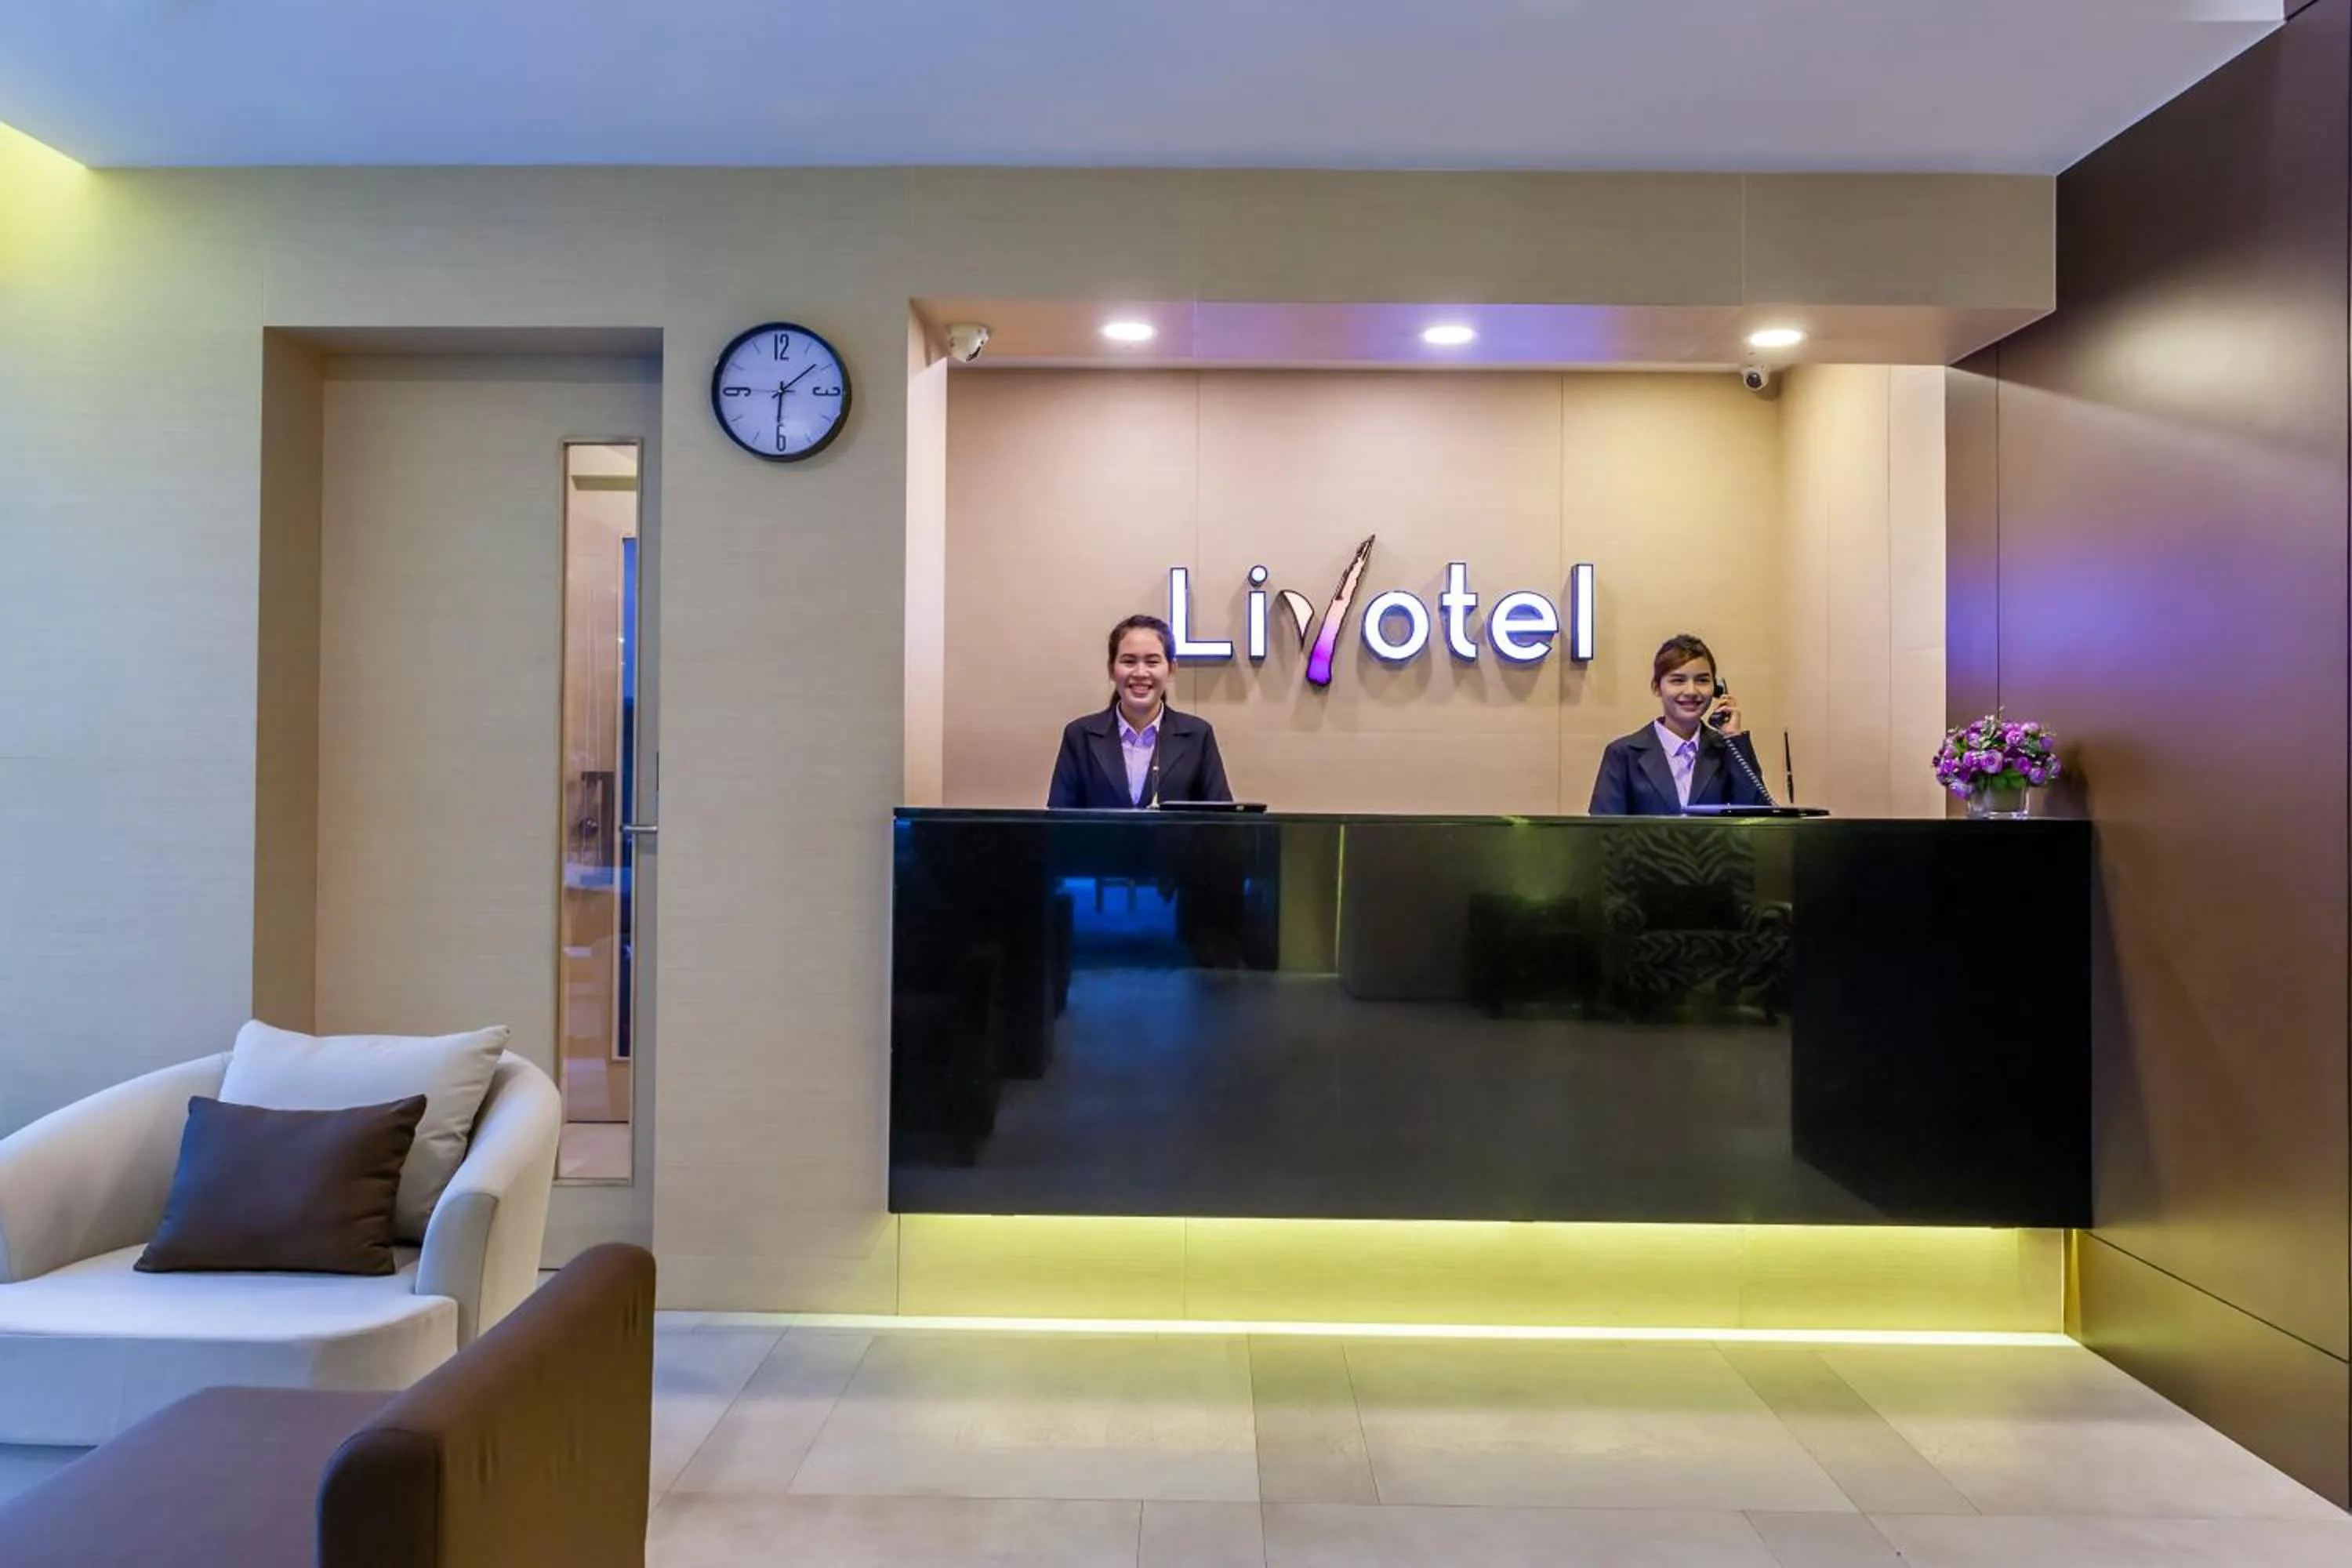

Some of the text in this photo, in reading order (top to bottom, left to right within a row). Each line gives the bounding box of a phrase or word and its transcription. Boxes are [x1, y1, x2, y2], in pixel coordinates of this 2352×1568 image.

[774, 333, 789, 361] 12
[723, 387, 751, 397] 9
[812, 387, 841, 397] 3
[776, 423, 786, 452] 6
[1169, 534, 1595, 688] Livotel
